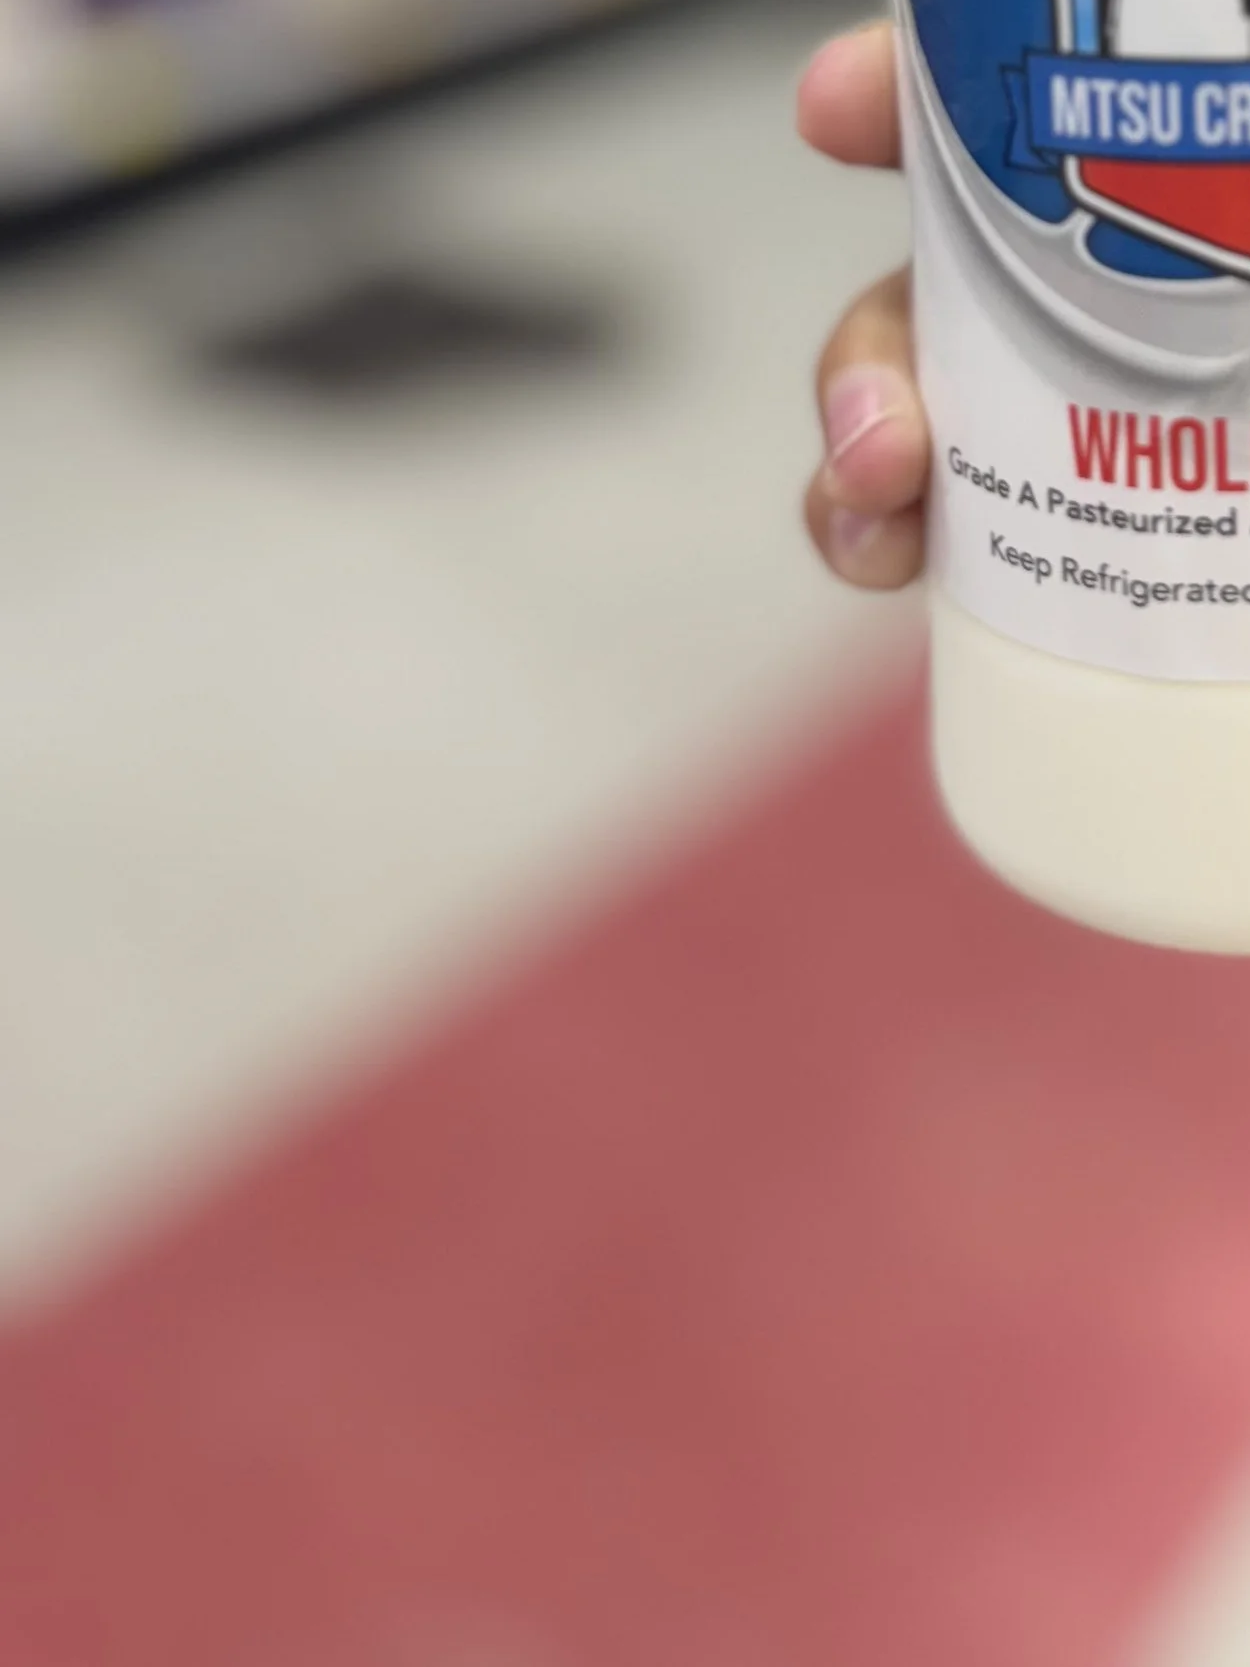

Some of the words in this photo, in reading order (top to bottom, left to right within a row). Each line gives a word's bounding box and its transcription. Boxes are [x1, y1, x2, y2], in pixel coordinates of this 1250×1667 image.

[1050, 74, 1182, 146] MTSU
[948, 446, 1010, 499] Grade
[1018, 481, 1039, 510] A
[1047, 489, 1238, 537] Pasteurized
[989, 531, 1052, 583] Keep
